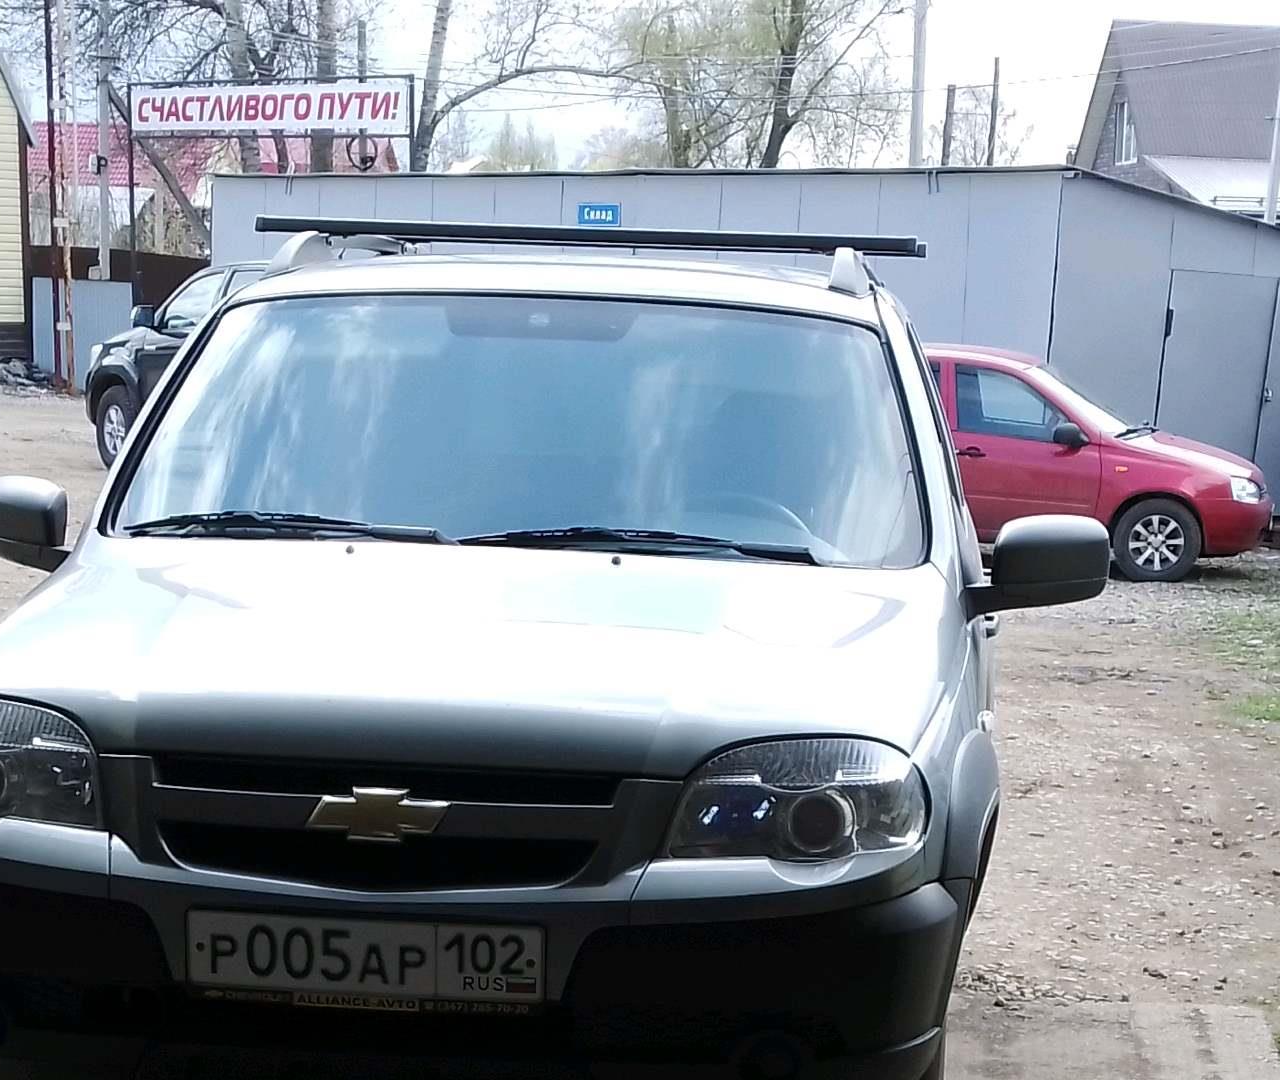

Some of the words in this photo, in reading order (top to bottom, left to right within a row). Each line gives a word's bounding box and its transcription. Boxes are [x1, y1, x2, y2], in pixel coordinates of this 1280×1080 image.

[137, 93, 312, 122] СЧАСТЛИВОГО
[316, 91, 401, 121] ПУТИ!
[443, 932, 526, 975] 102
[462, 975, 504, 992] RUS
